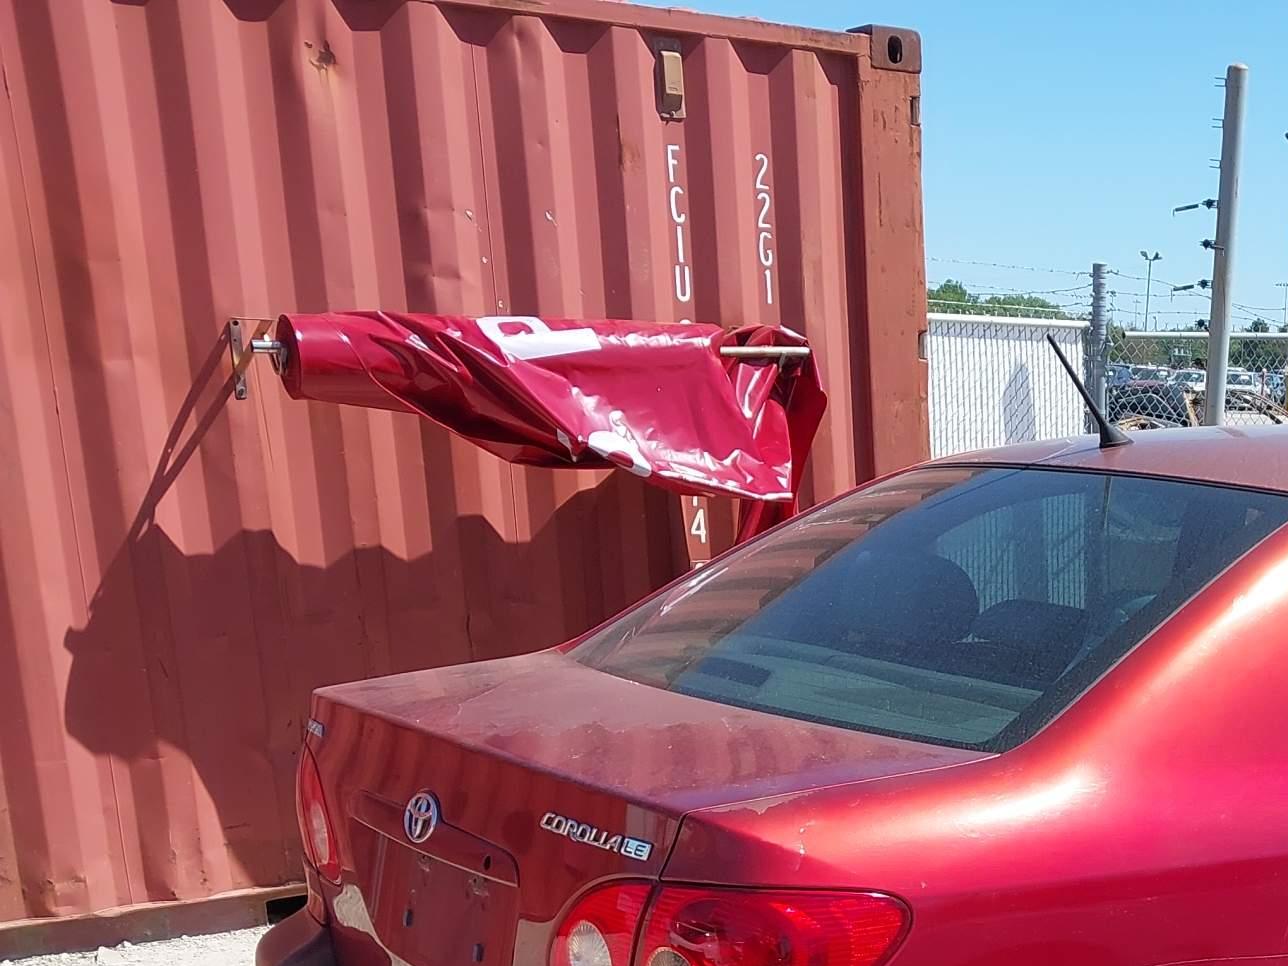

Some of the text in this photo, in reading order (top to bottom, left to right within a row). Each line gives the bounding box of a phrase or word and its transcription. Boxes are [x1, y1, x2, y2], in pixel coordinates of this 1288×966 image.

[666, 144, 691, 304] FCIU
[754, 153, 775, 305] 22G1
[539, 811, 647, 858] COROLLA LE
